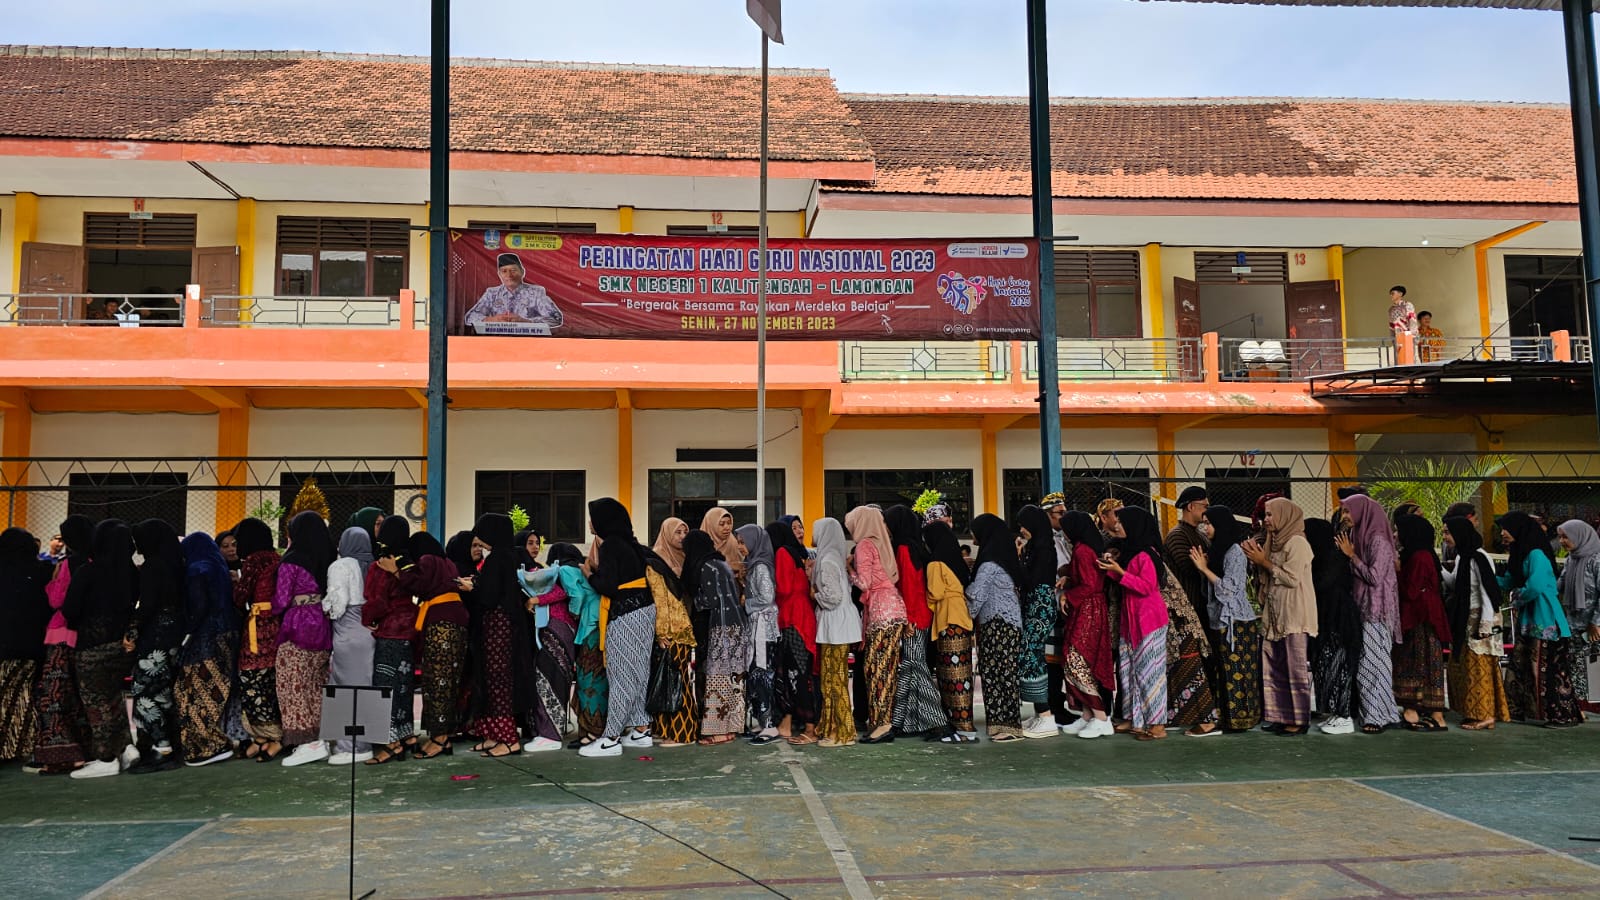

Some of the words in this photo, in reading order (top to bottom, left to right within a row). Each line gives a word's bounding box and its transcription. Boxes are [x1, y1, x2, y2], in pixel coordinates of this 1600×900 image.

[711, 211, 723, 225] 12
[580, 246, 694, 270] PERINGATAN
[700, 249, 743, 271] HARI
[799, 250, 886, 272] NASIONAL
[891, 250, 935, 272] 2023
[1294, 253, 1306, 266] 13
[599, 276, 632, 292] SMK
[636, 277, 694, 293] NEGERI
[699, 278, 707, 293] 1
[831, 279, 914, 295] LAMONGAN
[684, 300, 734, 311] Bersama
[795, 301, 846, 312] Merdeka
[681, 316, 720, 330] SENIN,
[724, 317, 737, 330] 27
[742, 317, 803, 330] NOEMBER
[807, 317, 836, 330] 2023
